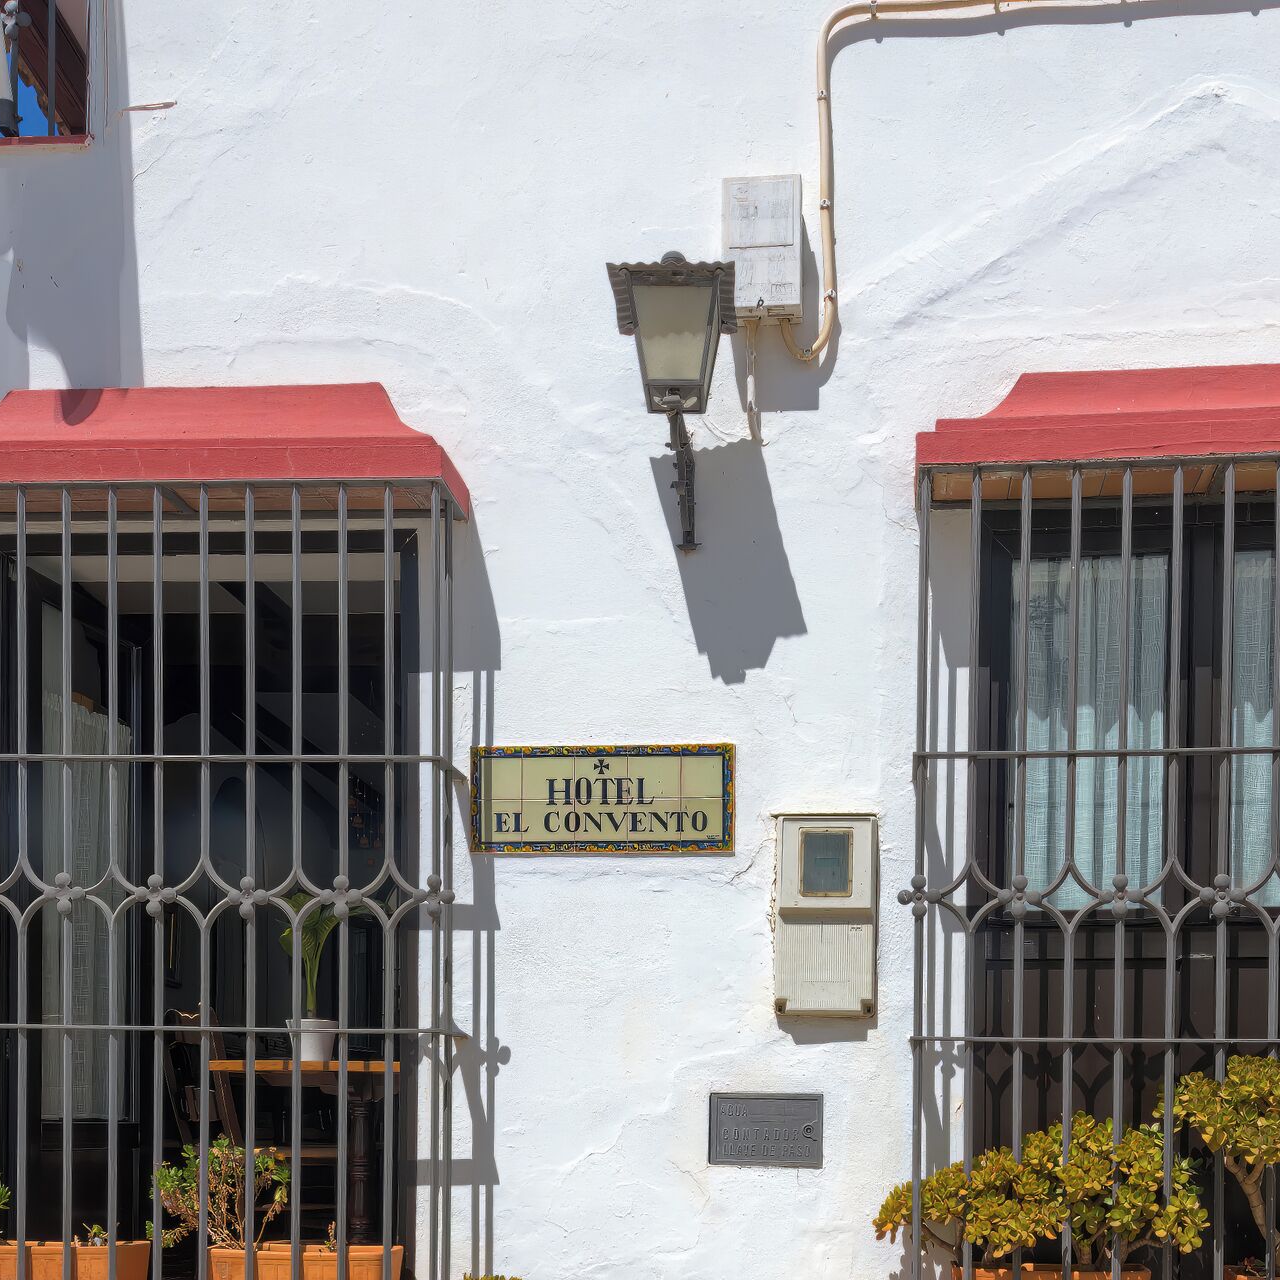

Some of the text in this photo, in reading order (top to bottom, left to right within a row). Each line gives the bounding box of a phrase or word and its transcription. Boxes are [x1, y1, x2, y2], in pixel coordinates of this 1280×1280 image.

[546, 777, 655, 806] HOTEL
[494, 809, 708, 834] EL CONVENTO
[722, 1127, 800, 1141] CONTADOR
[723, 1142, 812, 1158] LLAVE DE PASO
